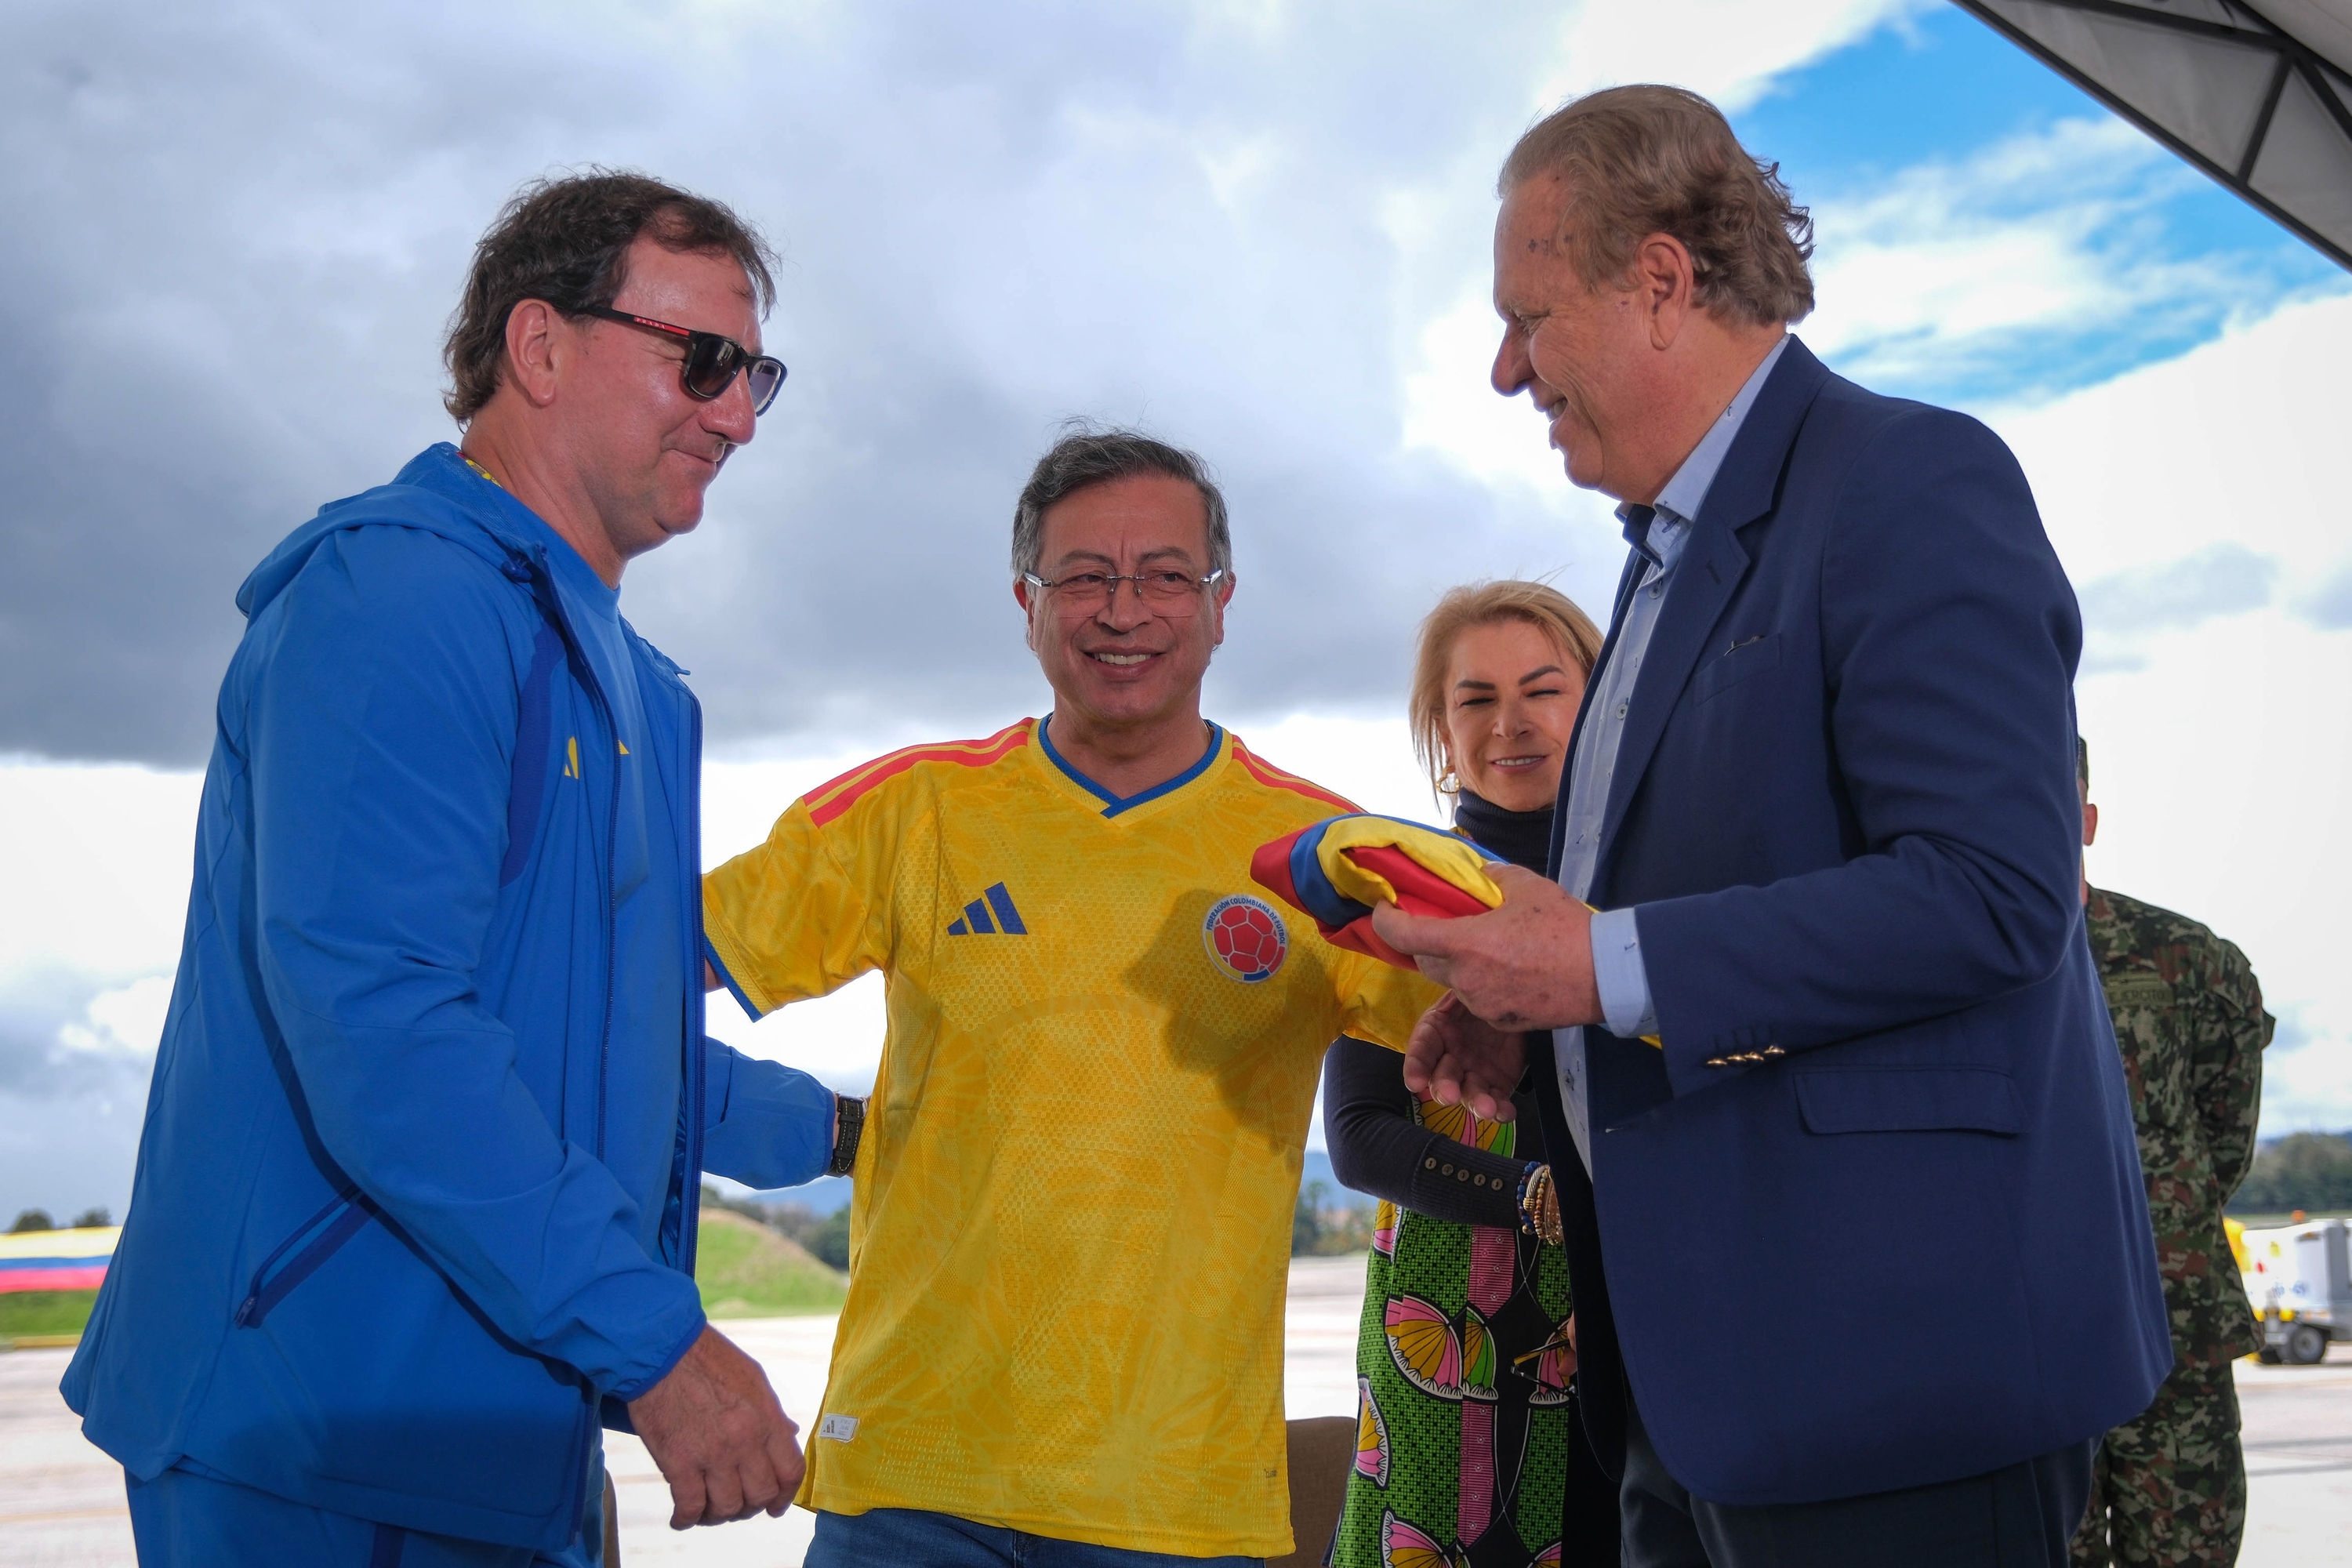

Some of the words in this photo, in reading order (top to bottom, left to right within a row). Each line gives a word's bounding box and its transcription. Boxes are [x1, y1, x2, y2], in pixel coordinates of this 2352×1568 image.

[636, 318, 666, 329] PRADA
[1206, 900, 1230, 931] FEDERACIÓN
[1230, 898, 1270, 914] COLOMBIANA
[1269, 912, 1277, 922] DE
